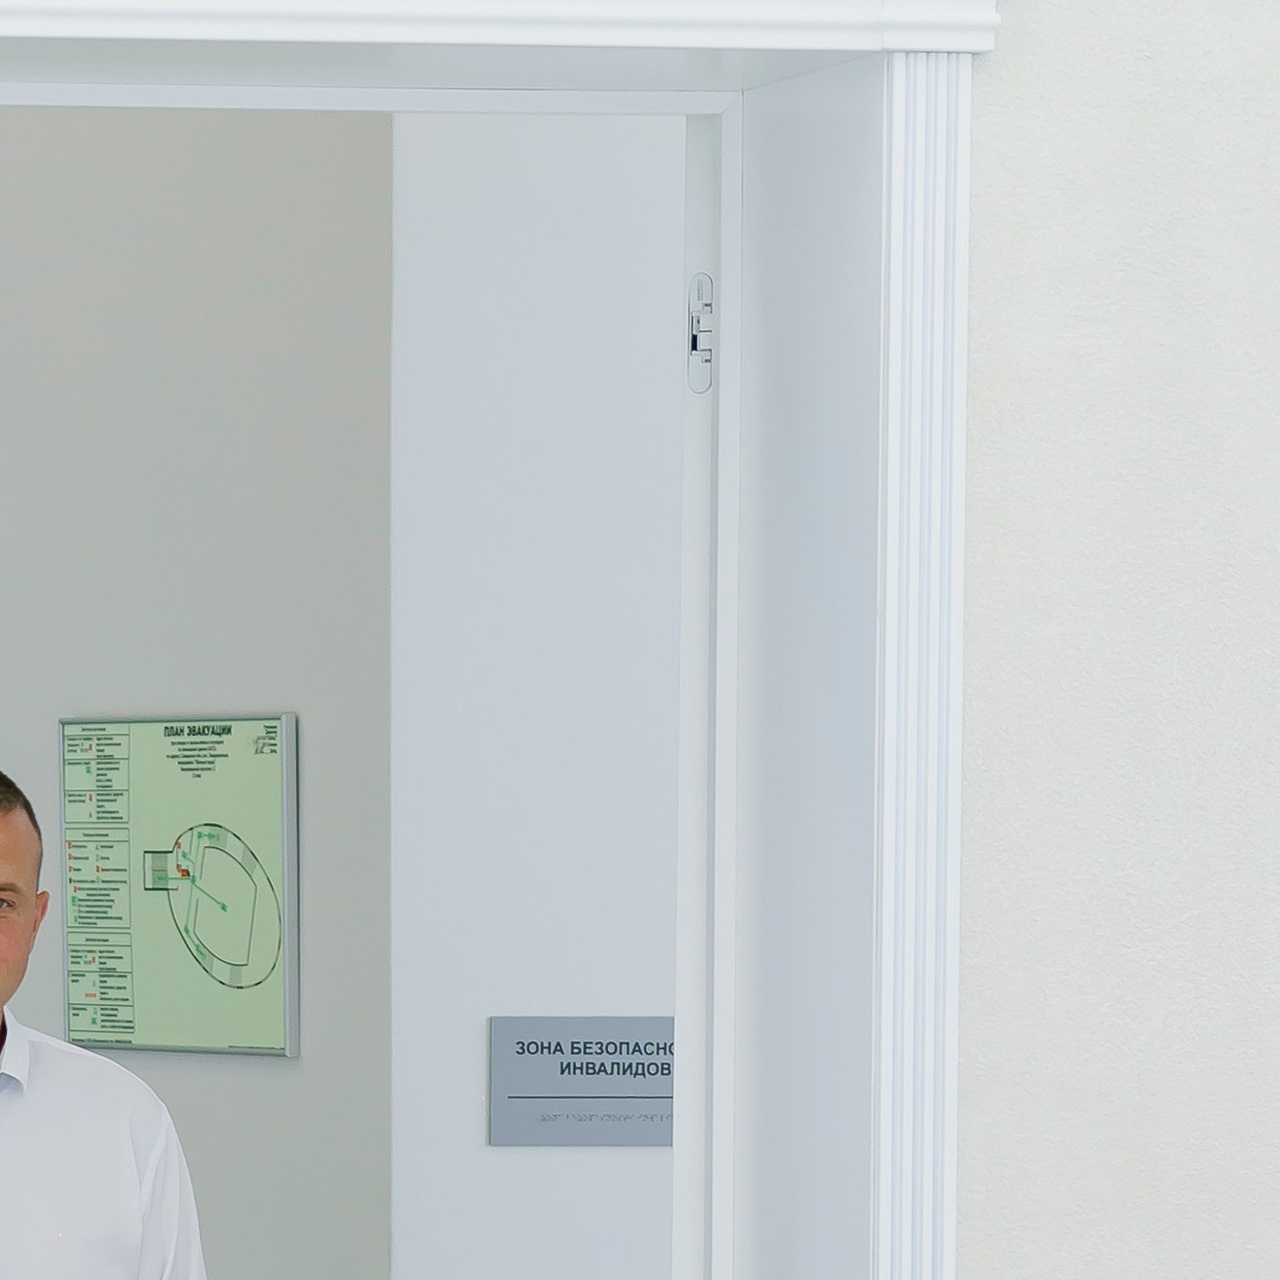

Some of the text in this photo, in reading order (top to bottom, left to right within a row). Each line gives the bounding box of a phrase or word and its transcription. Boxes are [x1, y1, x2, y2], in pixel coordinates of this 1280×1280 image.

[163, 725, 232, 738] ПЛАН ЭВАКУАЦИИ
[515, 1041, 565, 1056] ЗОНА
[560, 1061, 672, 1079] ИНВАЛИДОВ
